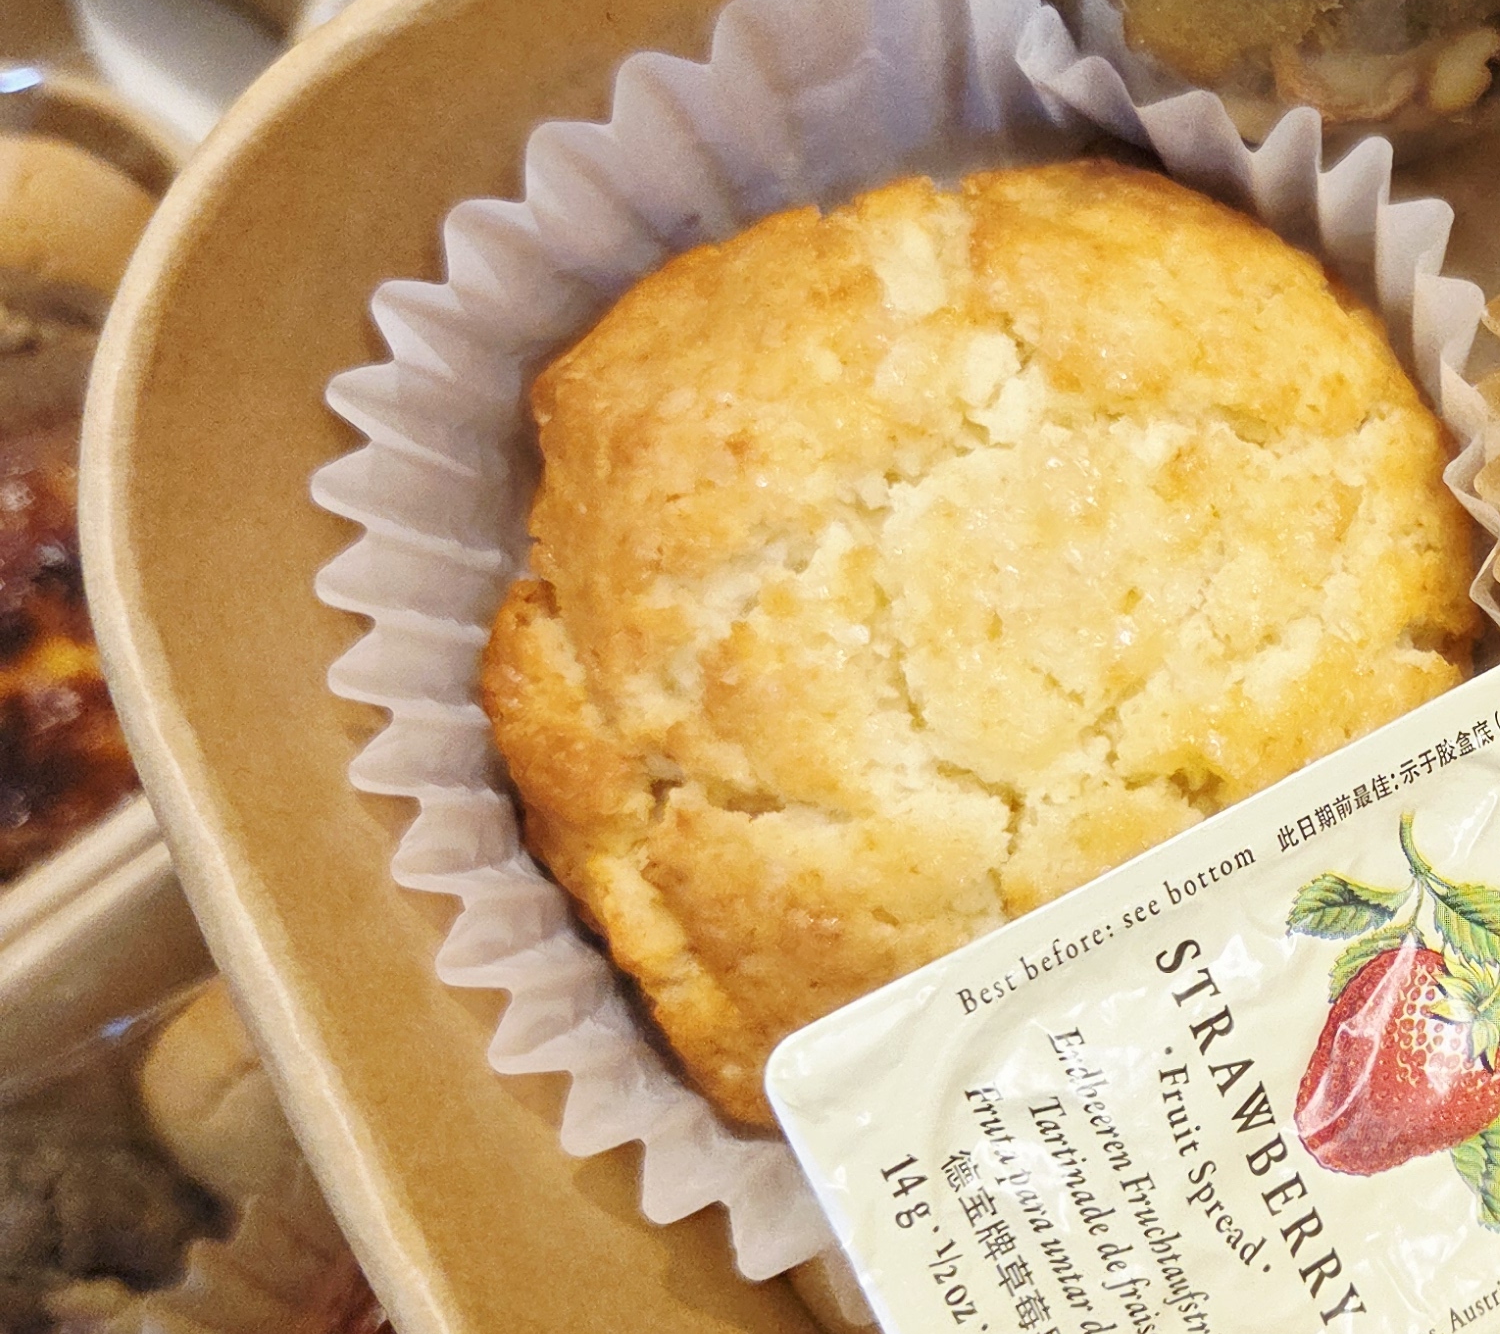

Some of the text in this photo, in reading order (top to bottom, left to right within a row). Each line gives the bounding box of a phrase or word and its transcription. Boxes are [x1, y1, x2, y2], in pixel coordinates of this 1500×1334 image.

[956, 847, 1256, 1015] Best before: see bottom
[1028, 1096, 1116, 1236] Tartinade
[1097, 1243, 1133, 1273] de
[1048, 1026, 1133, 1171] Erdbeeren
[1155, 938, 1367, 1327] STRAWBERRY
[1157, 1064, 1268, 1267] Fruit Spread
[964, 1081, 1016, 1166] Fruta
[995, 1167, 1054, 1233] para
[1041, 1238, 1094, 1313] untar
